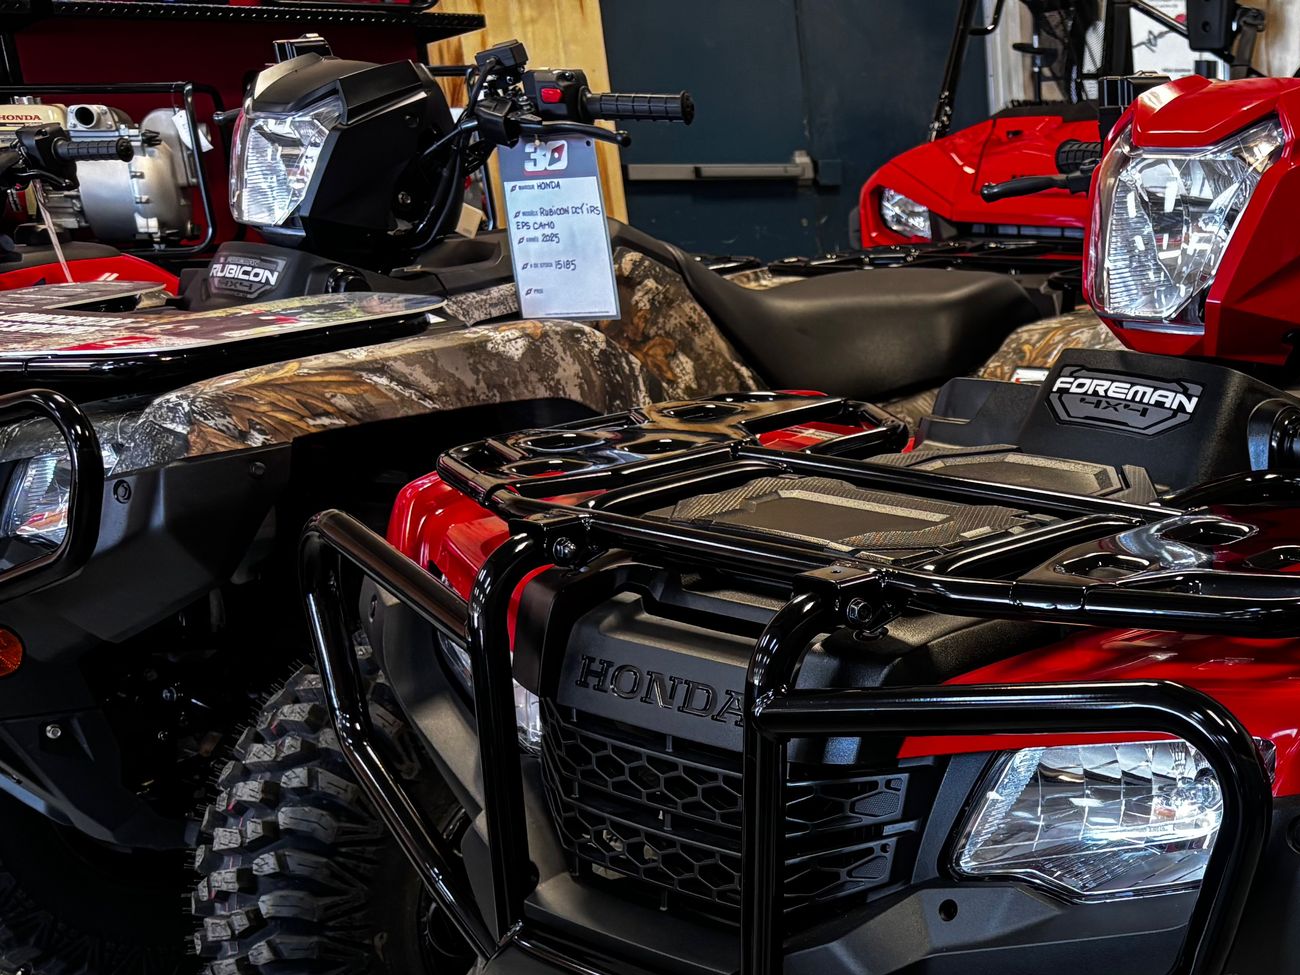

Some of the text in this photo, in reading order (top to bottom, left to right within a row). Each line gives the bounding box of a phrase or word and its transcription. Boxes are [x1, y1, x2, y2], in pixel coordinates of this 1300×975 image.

[536, 181, 561, 191] HONDA
[516, 221, 531, 230] EPS
[541, 233, 560, 243] 2025
[554, 259, 577, 271] 15185
[210, 263, 279, 285] RUBICON
[1052, 376, 1199, 414] FOREMAN
[575, 653, 745, 727] HONDA
